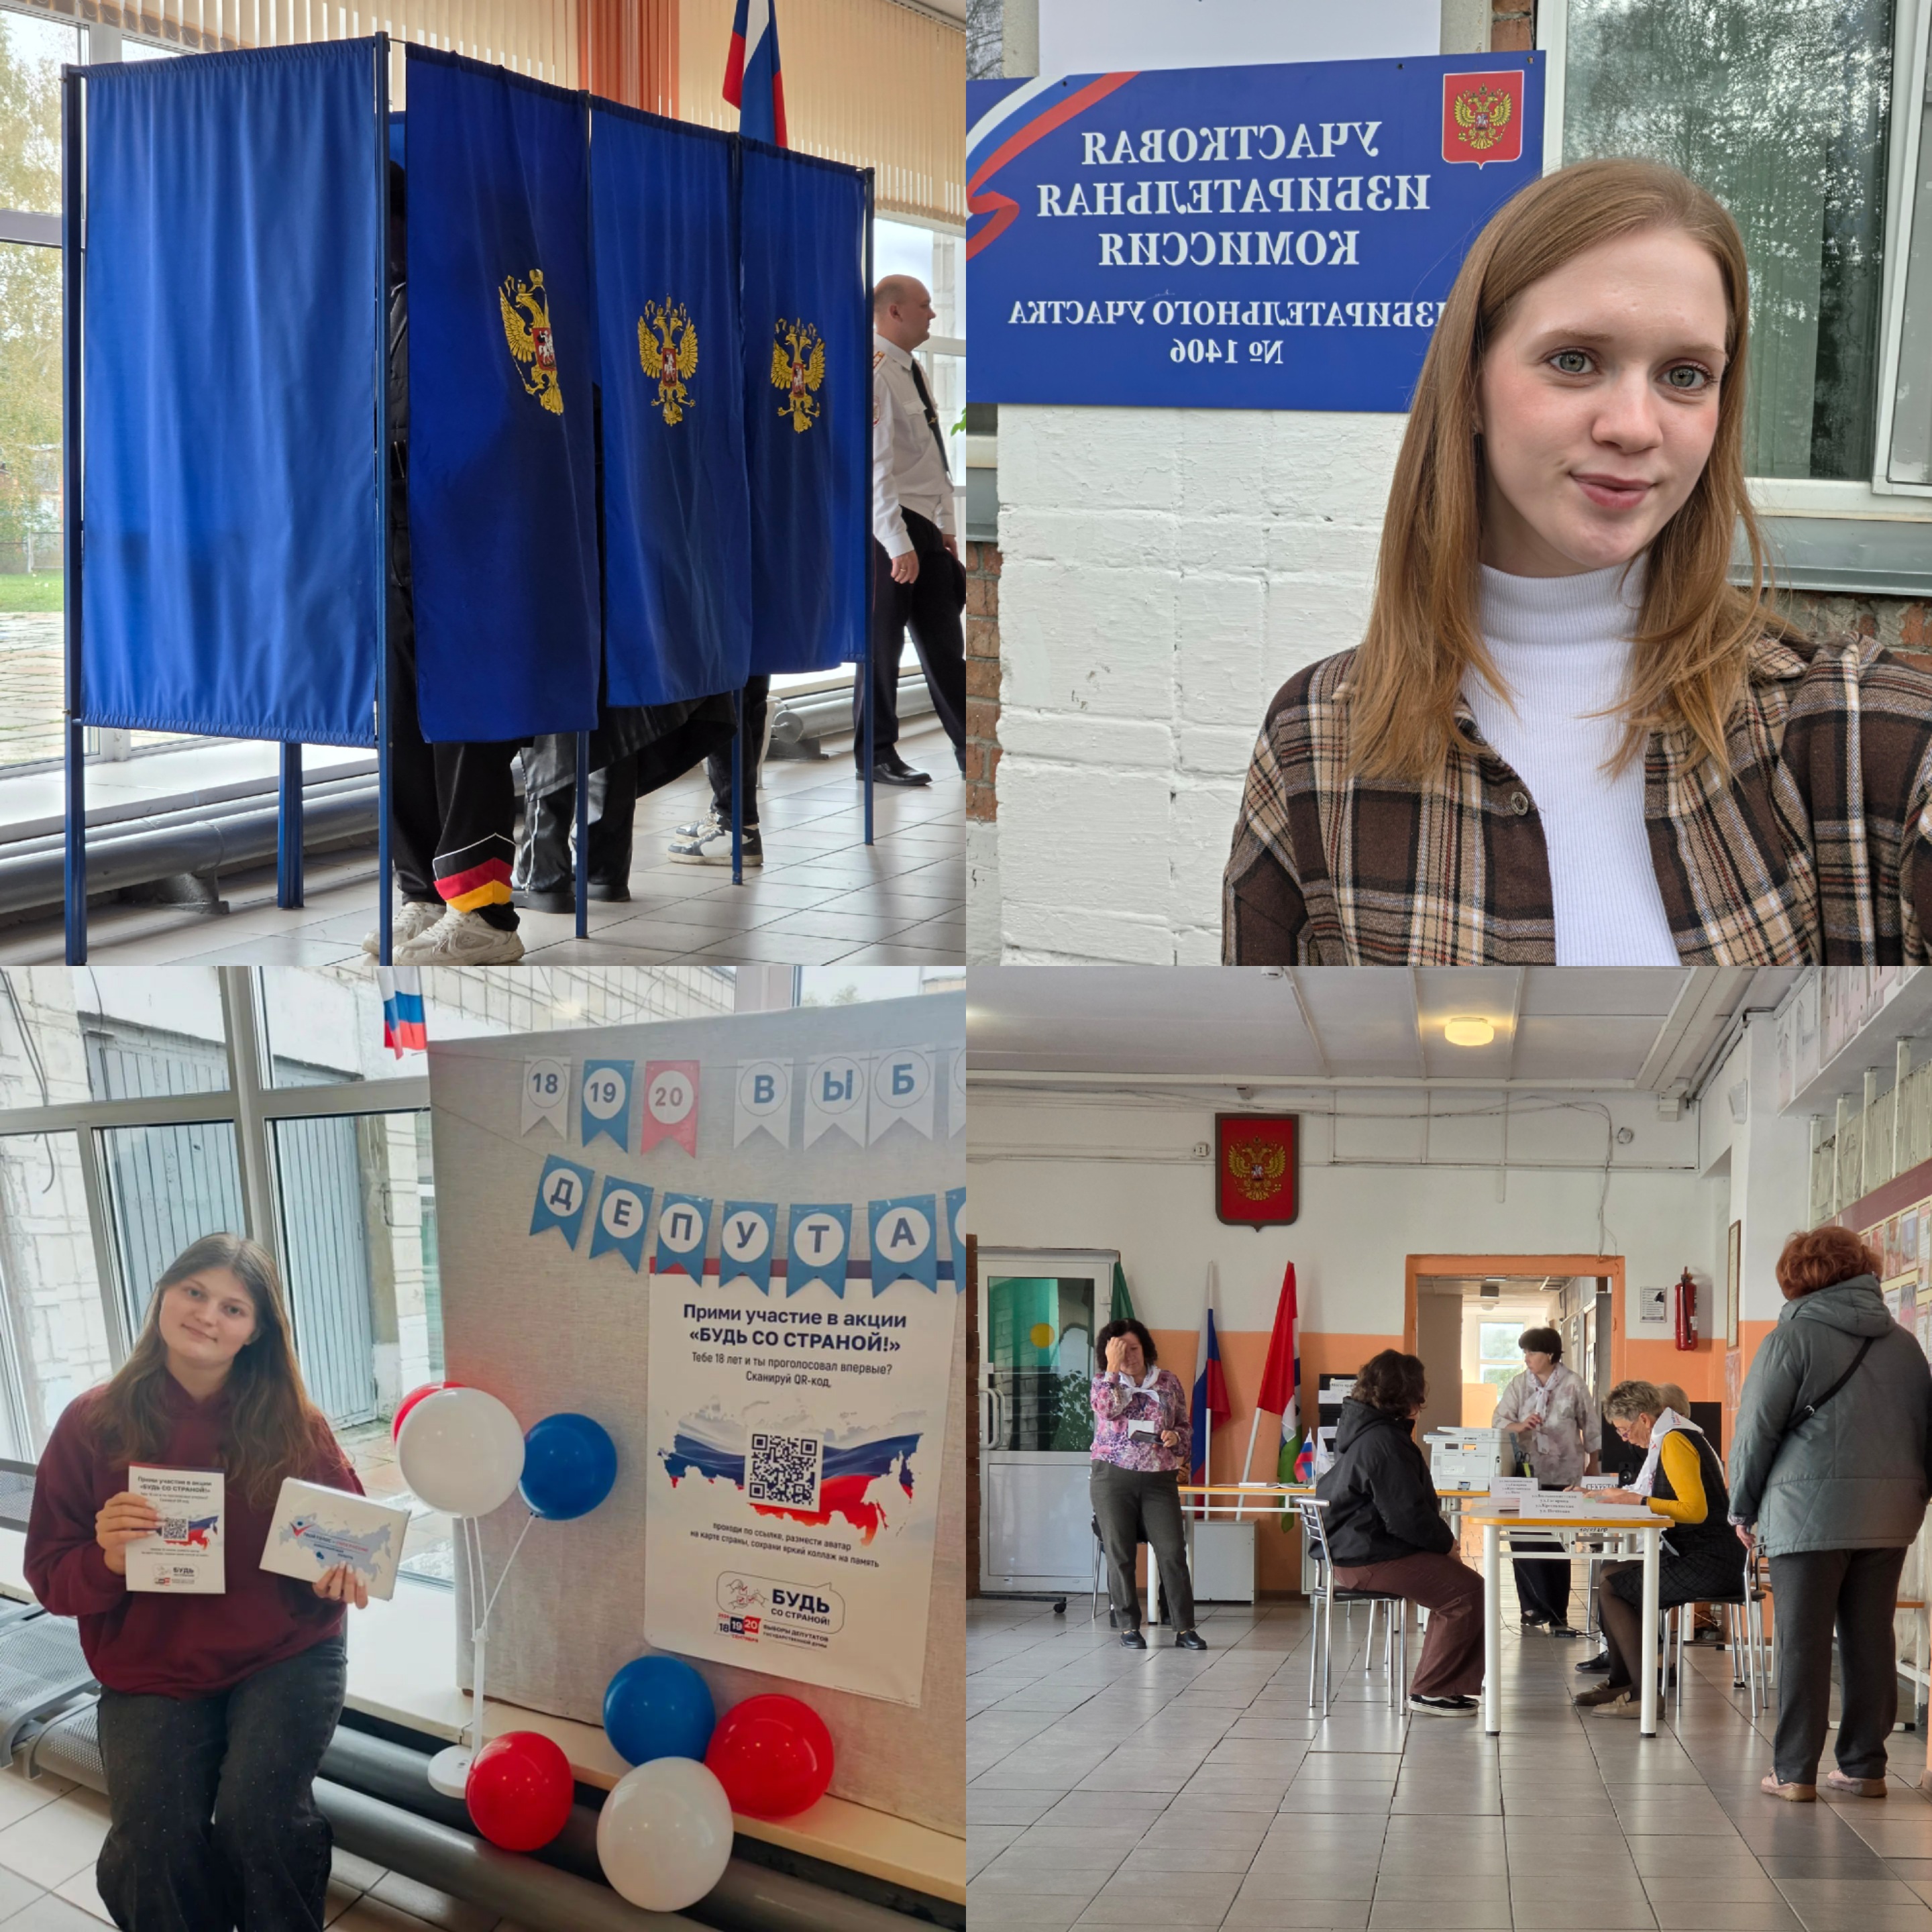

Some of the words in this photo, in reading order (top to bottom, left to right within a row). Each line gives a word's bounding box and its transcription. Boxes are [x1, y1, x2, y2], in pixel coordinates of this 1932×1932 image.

[532, 1071, 558, 1095] 18
[589, 1081, 616, 1104] 19
[654, 1085, 684, 1108] 20
[684, 1303, 741, 1322] Прими
[746, 1309, 822, 1325] участие
[826, 1313, 839, 1325] в
[843, 1314, 907, 1330] акции
[690, 1327, 748, 1346] «БУДЬ
[752, 1330, 779, 1346] СО
[784, 1332, 900, 1352] СТРАНОЙ!»
[692, 1352, 713, 1362] Тебе
[715, 1353, 725, 1363] 18
[727, 1355, 743, 1364] лет
[745, 1357, 751, 1365] и
[753, 1358, 765, 1366] ты
[768, 1359, 838, 1372] проголосовал
[841, 1363, 892, 1375] впервые?
[745, 1371, 792, 1385] Сканируй
[690, 1529, 699, 1538] на
[700, 1532, 720, 1541] карте
[751, 1540, 782, 1552] сохрани
[782, 1545, 806, 1556] яркий
[807, 1550, 837, 1561] коллаж
[839, 1555, 849, 1563] на
[850, 1556, 879, 1568] память
[743, 1527, 753, 1536] по
[785, 1534, 822, 1546] размести
[824, 1540, 851, 1552] аватар
[772, 1588, 830, 1614] БУДЬ
[718, 1623, 730, 1633] 18
[732, 1620, 743, 1631] 19
[743, 1618, 758, 1629] 20
[771, 1608, 783, 1617] СО
[784, 1611, 830, 1626] СТРАНОЙ!
